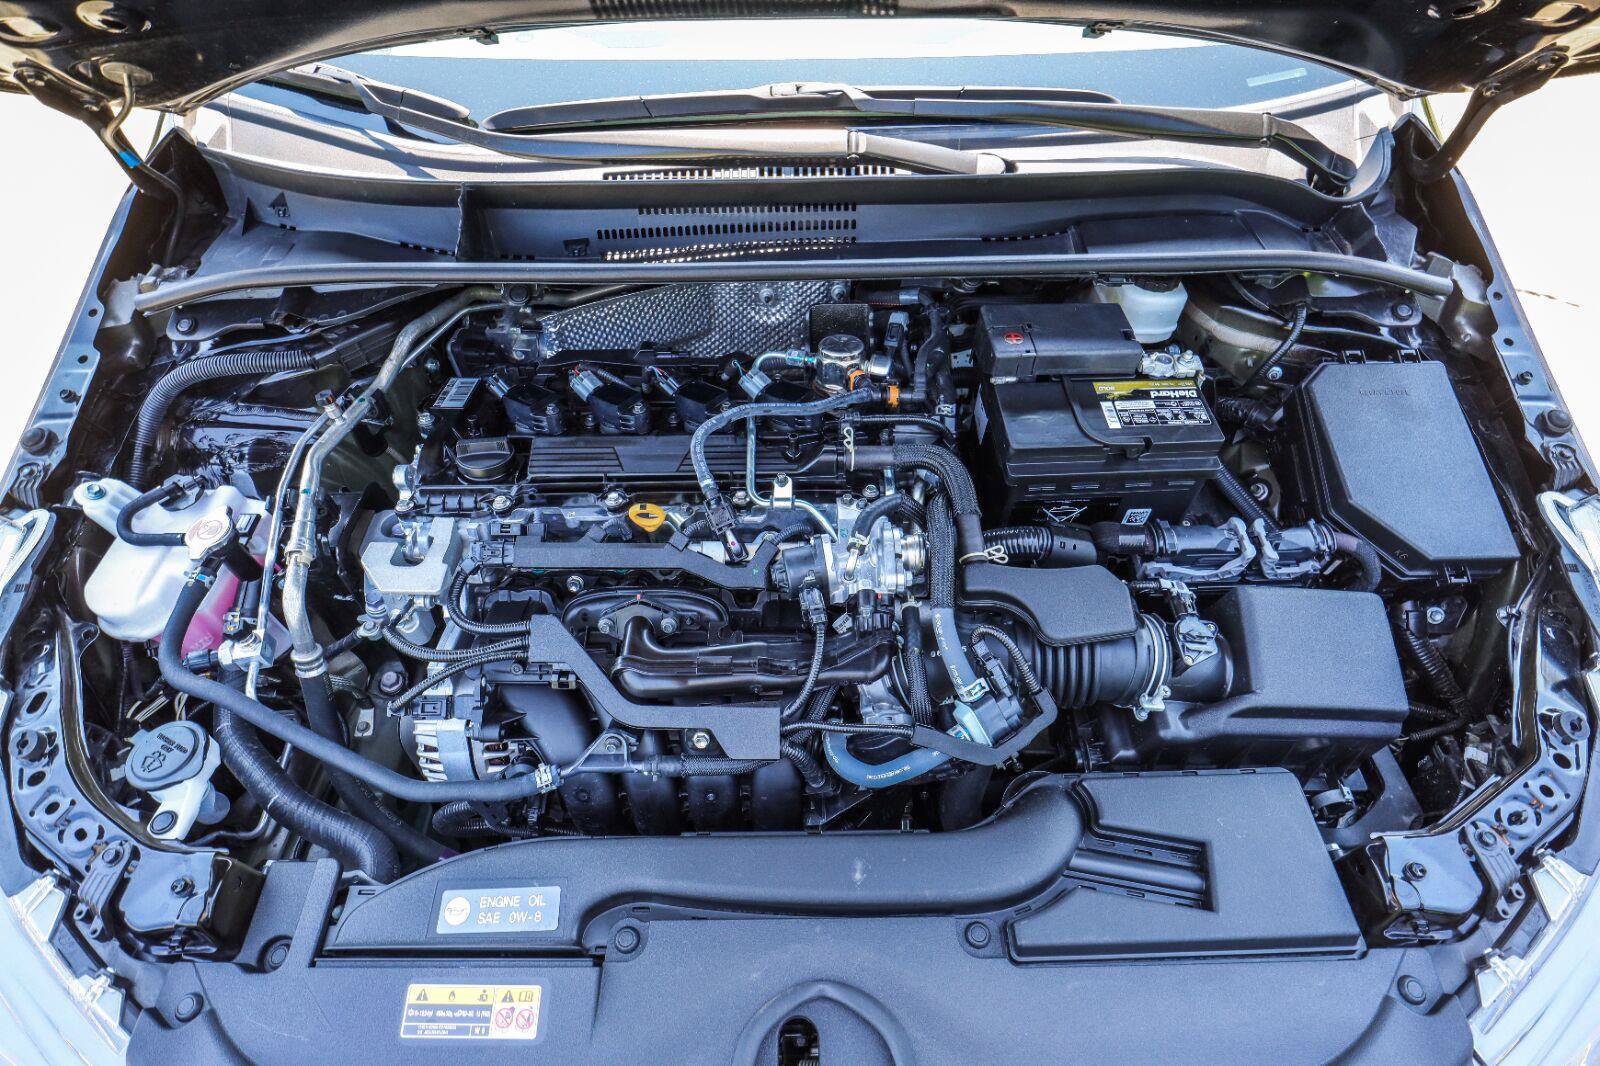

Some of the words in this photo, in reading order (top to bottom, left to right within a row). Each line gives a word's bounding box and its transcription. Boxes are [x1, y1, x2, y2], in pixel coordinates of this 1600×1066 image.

[1150, 389, 1198, 398] DieHard
[479, 895, 521, 908] ENGINE
[528, 894, 546, 907] OIL
[477, 911, 501, 924] SAE
[508, 910, 542, 924] 0W-8
